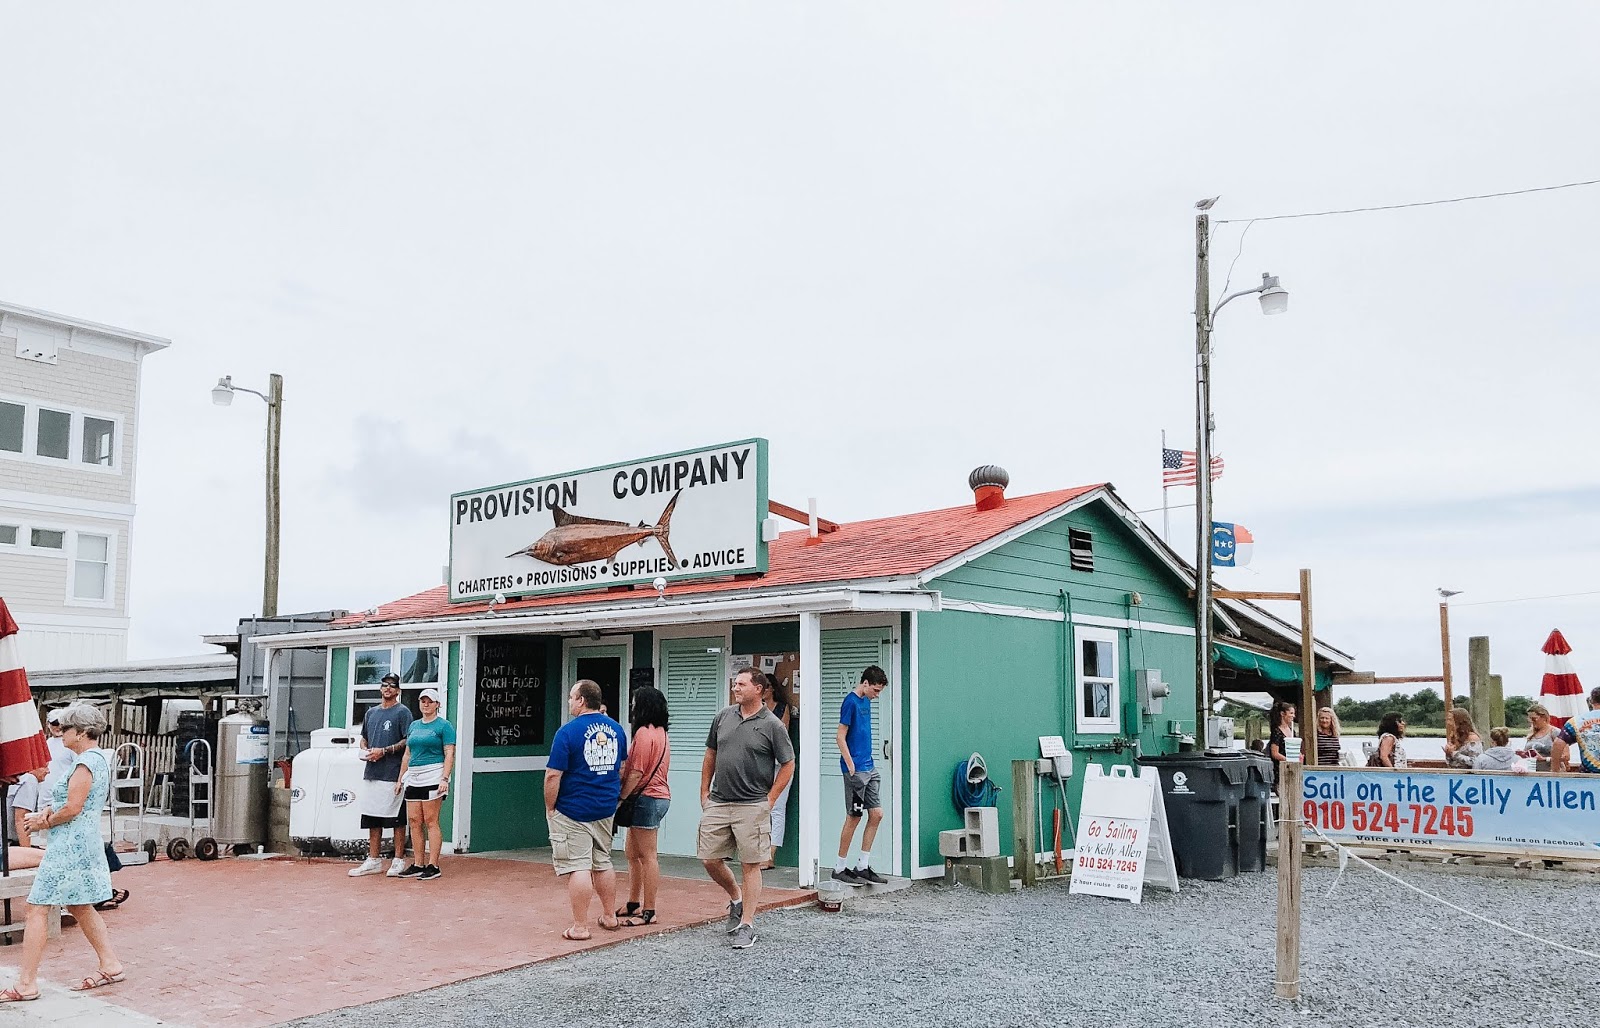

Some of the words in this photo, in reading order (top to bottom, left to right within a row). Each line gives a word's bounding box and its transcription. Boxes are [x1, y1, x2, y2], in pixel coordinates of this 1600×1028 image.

[456, 479, 577, 525] PROVISION
[613, 448, 750, 499] COMPANY
[458, 575, 513, 594] CHARTERS
[526, 565, 597, 586] PROVISIONS
[612, 557, 675, 577] SUPPLIES
[693, 548, 745, 568] ADVICE
[480, 691, 502, 703] KEEP
[503, 691, 517, 703] IT
[485, 704, 532, 718] SHRIMPLE
[1303, 774, 1345, 800] Sail
[1356, 782, 1383, 801] on
[1394, 776, 1435, 803] the
[1449, 778, 1512, 814] Kelly
[1526, 780, 1596, 811] Allen
[1303, 800, 1345, 831] 910
[1352, 801, 1474, 838] 524-7245
[1088, 820, 1102, 838] Go
[1105, 820, 1138, 845] Sailing
[1356, 835, 1389, 843] Voice
[1094, 842, 1117, 860] Kelly
[1118, 843, 1142, 858] Allen
[1543, 838, 1585, 847] facebook
[1079, 856, 1095, 869] 910
[1097, 858, 1138, 873] 524-7245
